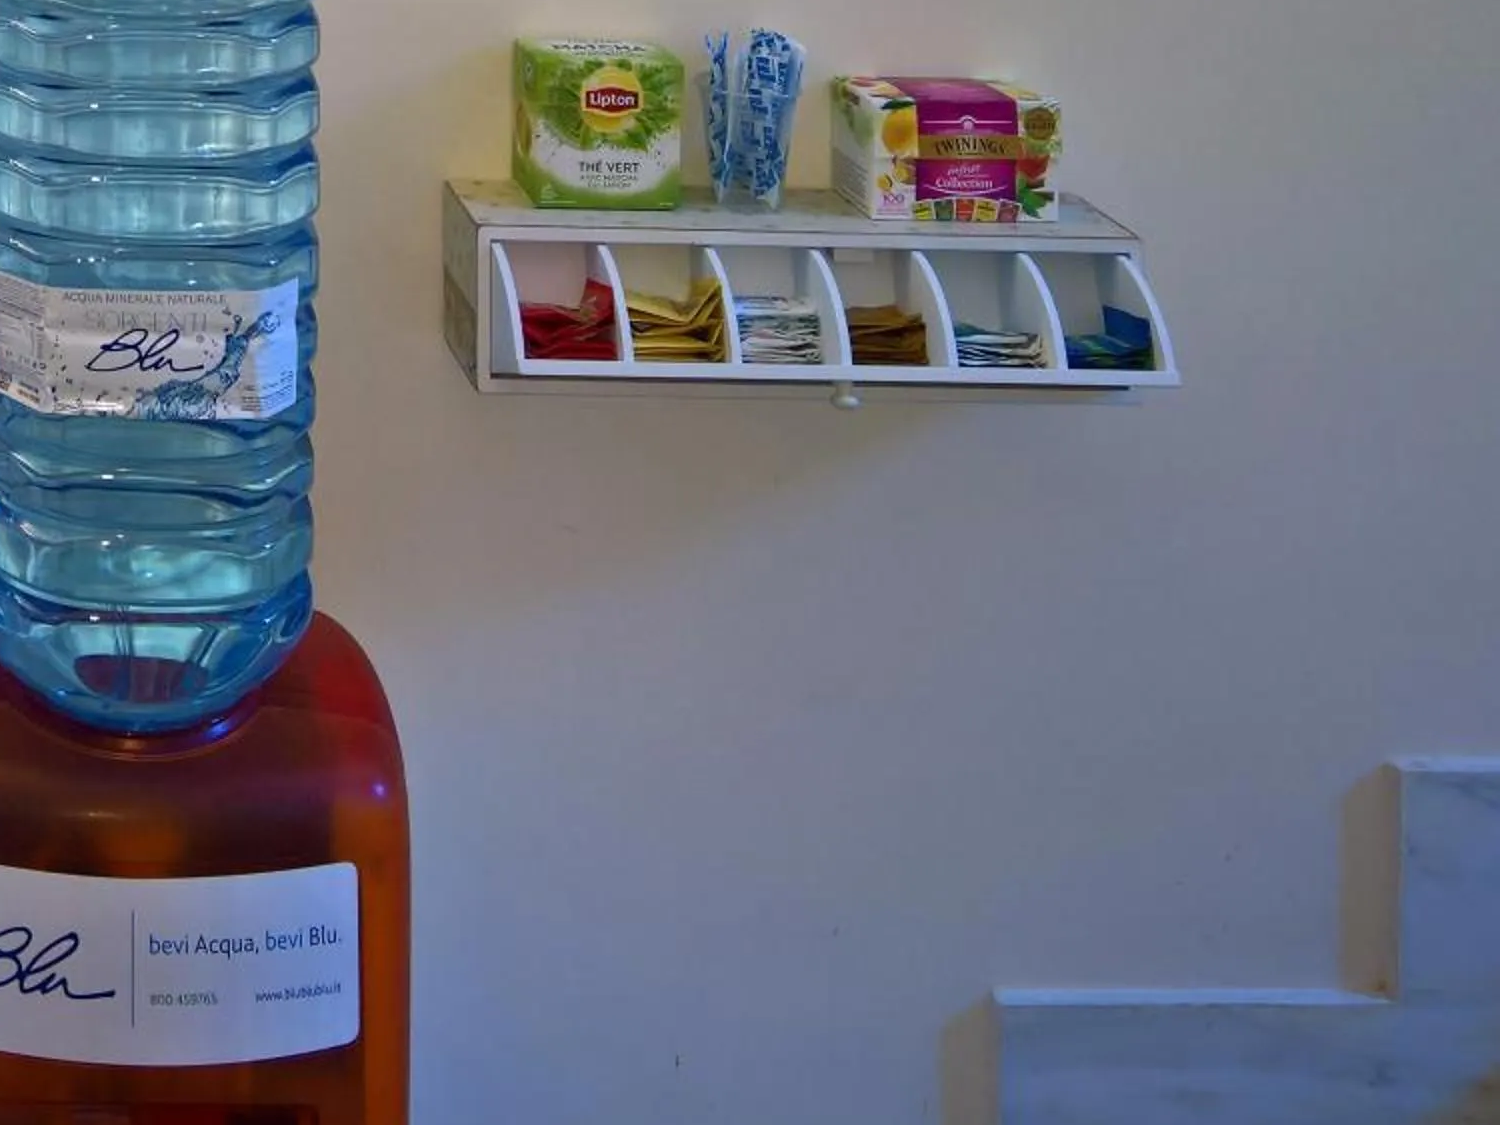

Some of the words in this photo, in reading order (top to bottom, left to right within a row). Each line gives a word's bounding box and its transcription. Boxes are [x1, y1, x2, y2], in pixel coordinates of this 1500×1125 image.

[589, 92, 635, 111] Lipton
[606, 161, 640, 173] VERT
[63, 292, 103, 304] ACQUA
[105, 293, 164, 304] MINERALE
[167, 294, 227, 305] NATURALE
[84, 328, 204, 372] Blu
[149, 934, 190, 955] bevi
[194, 935, 260, 960] Acqua,
[265, 930, 304, 951] bevi
[309, 927, 343, 947] Blu.
